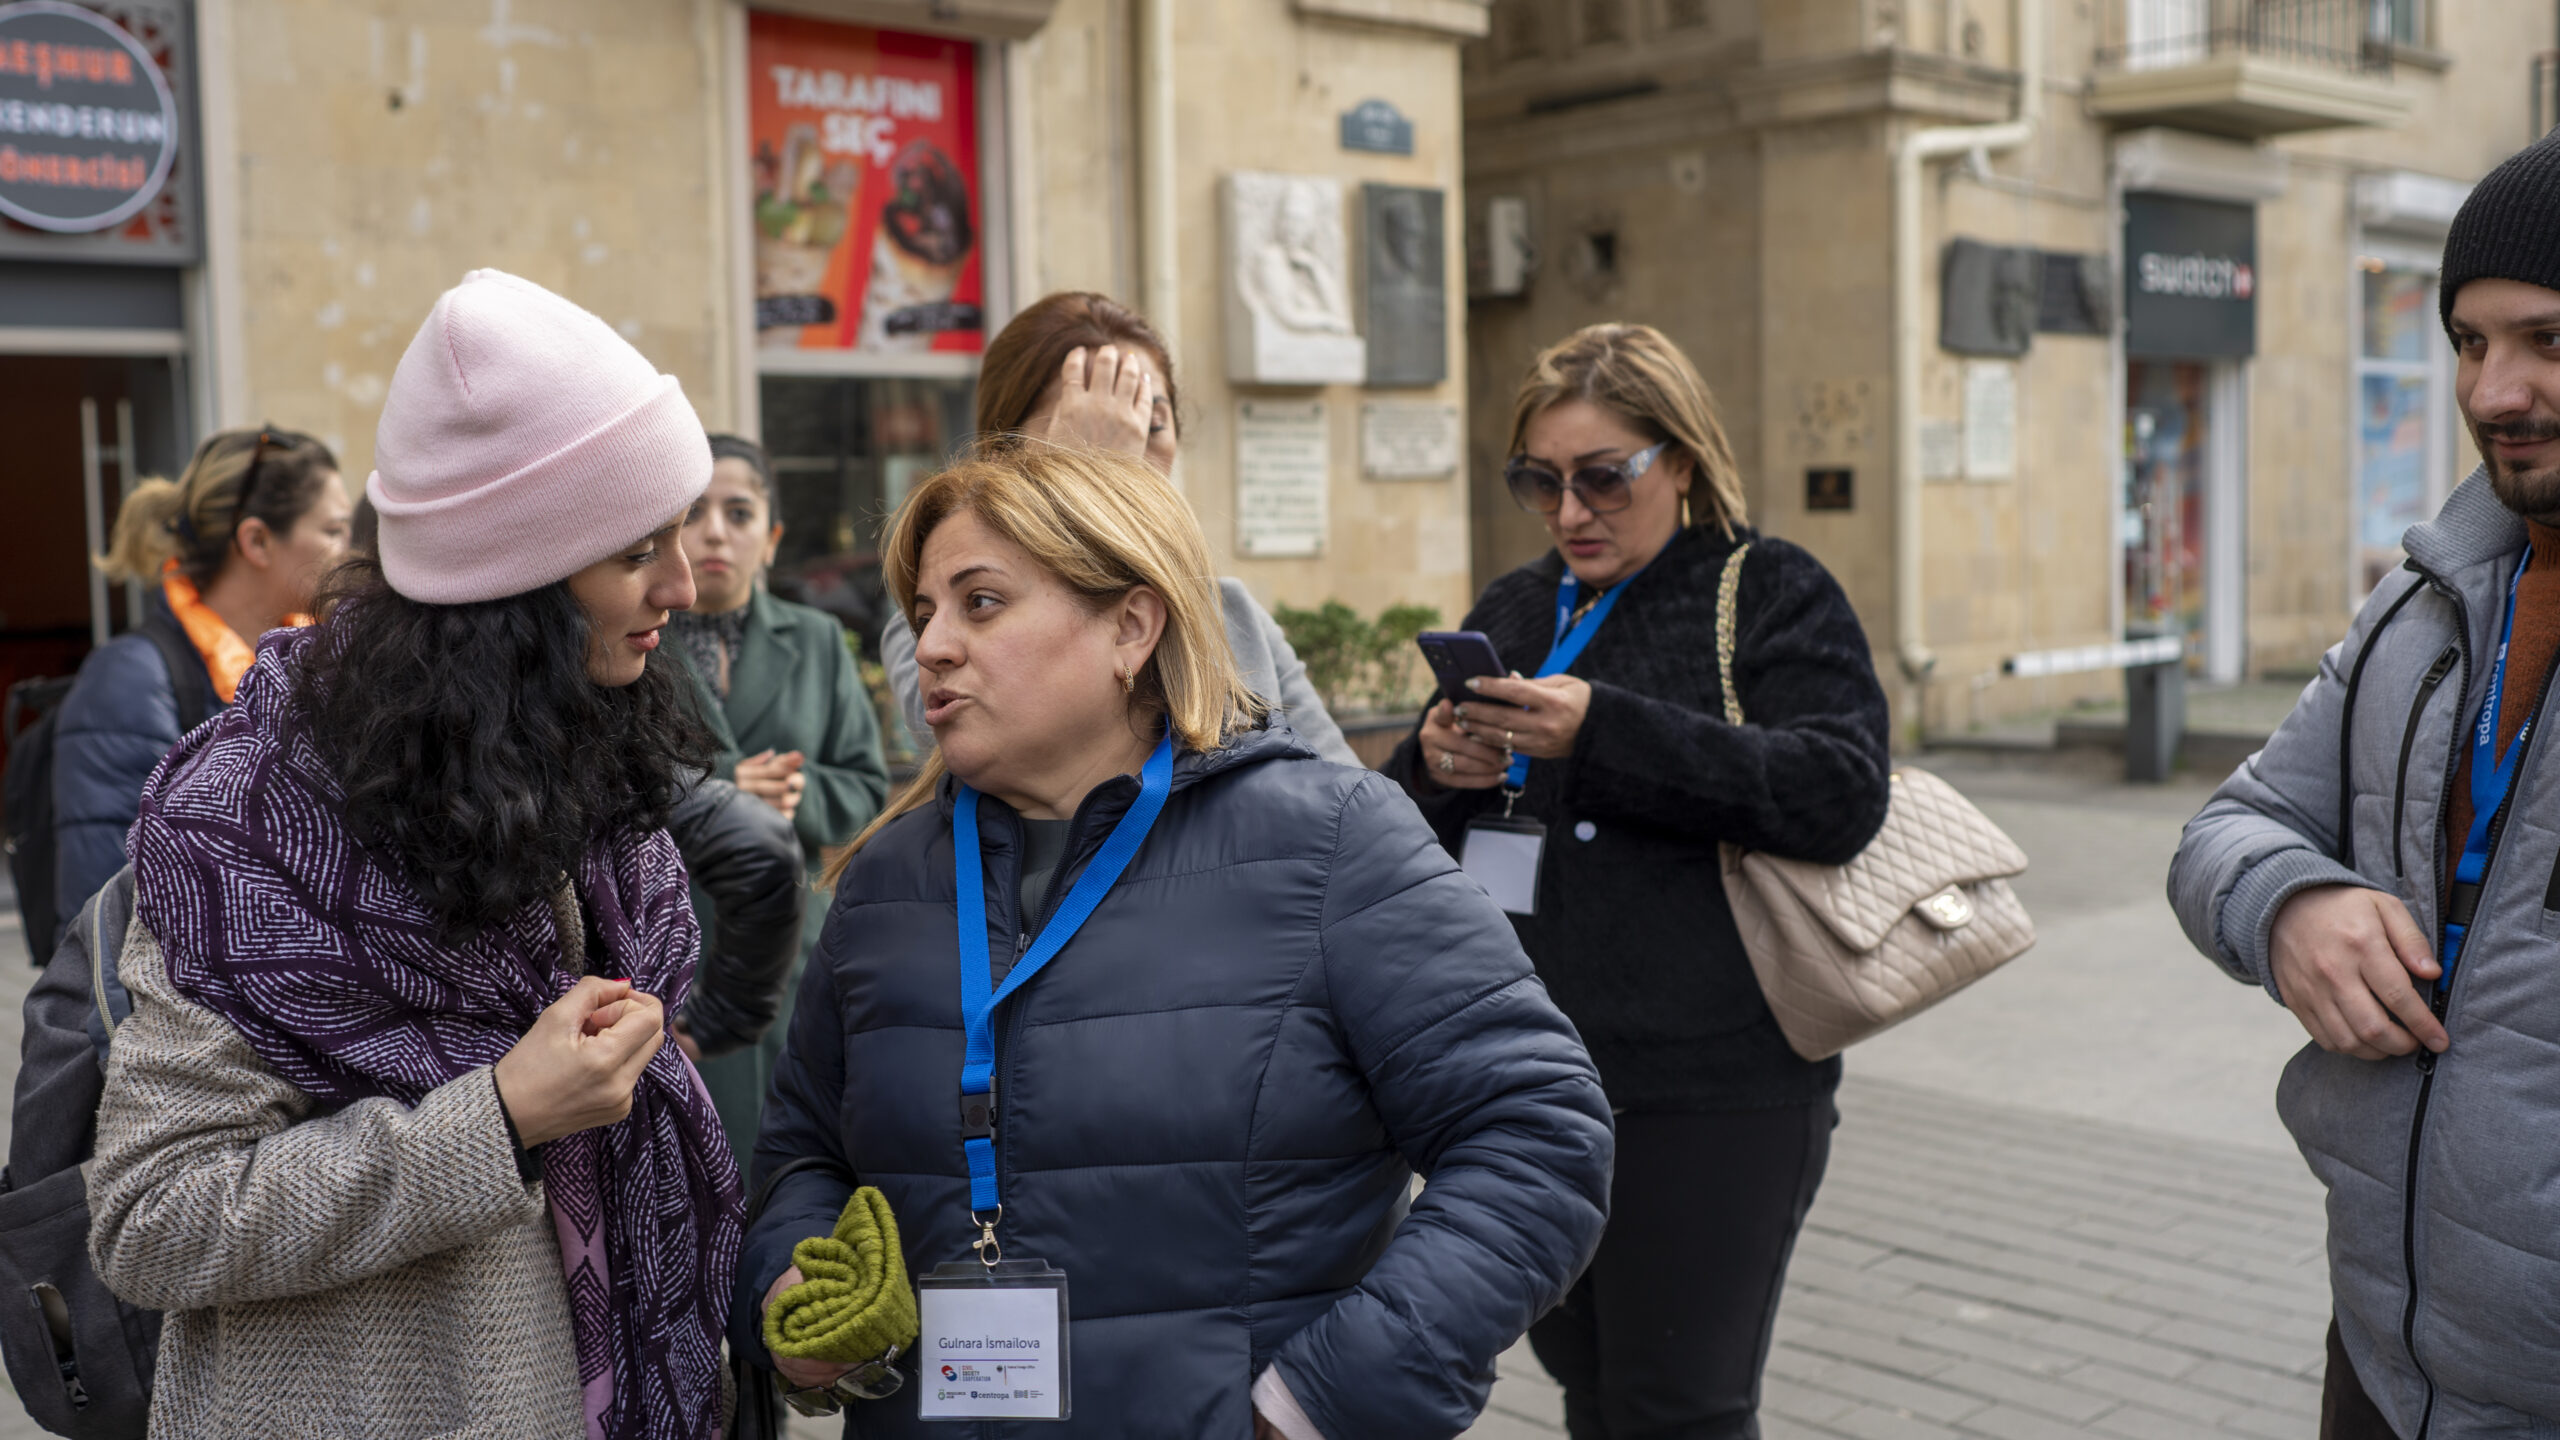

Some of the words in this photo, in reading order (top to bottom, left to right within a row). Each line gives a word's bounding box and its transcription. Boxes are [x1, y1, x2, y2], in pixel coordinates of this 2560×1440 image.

[822, 111, 897, 169] SEÇ
[2139, 251, 2237, 298] swatch
[938, 1337, 982, 1349] Gulnara
[978, 1391, 1010, 1400] centropa
